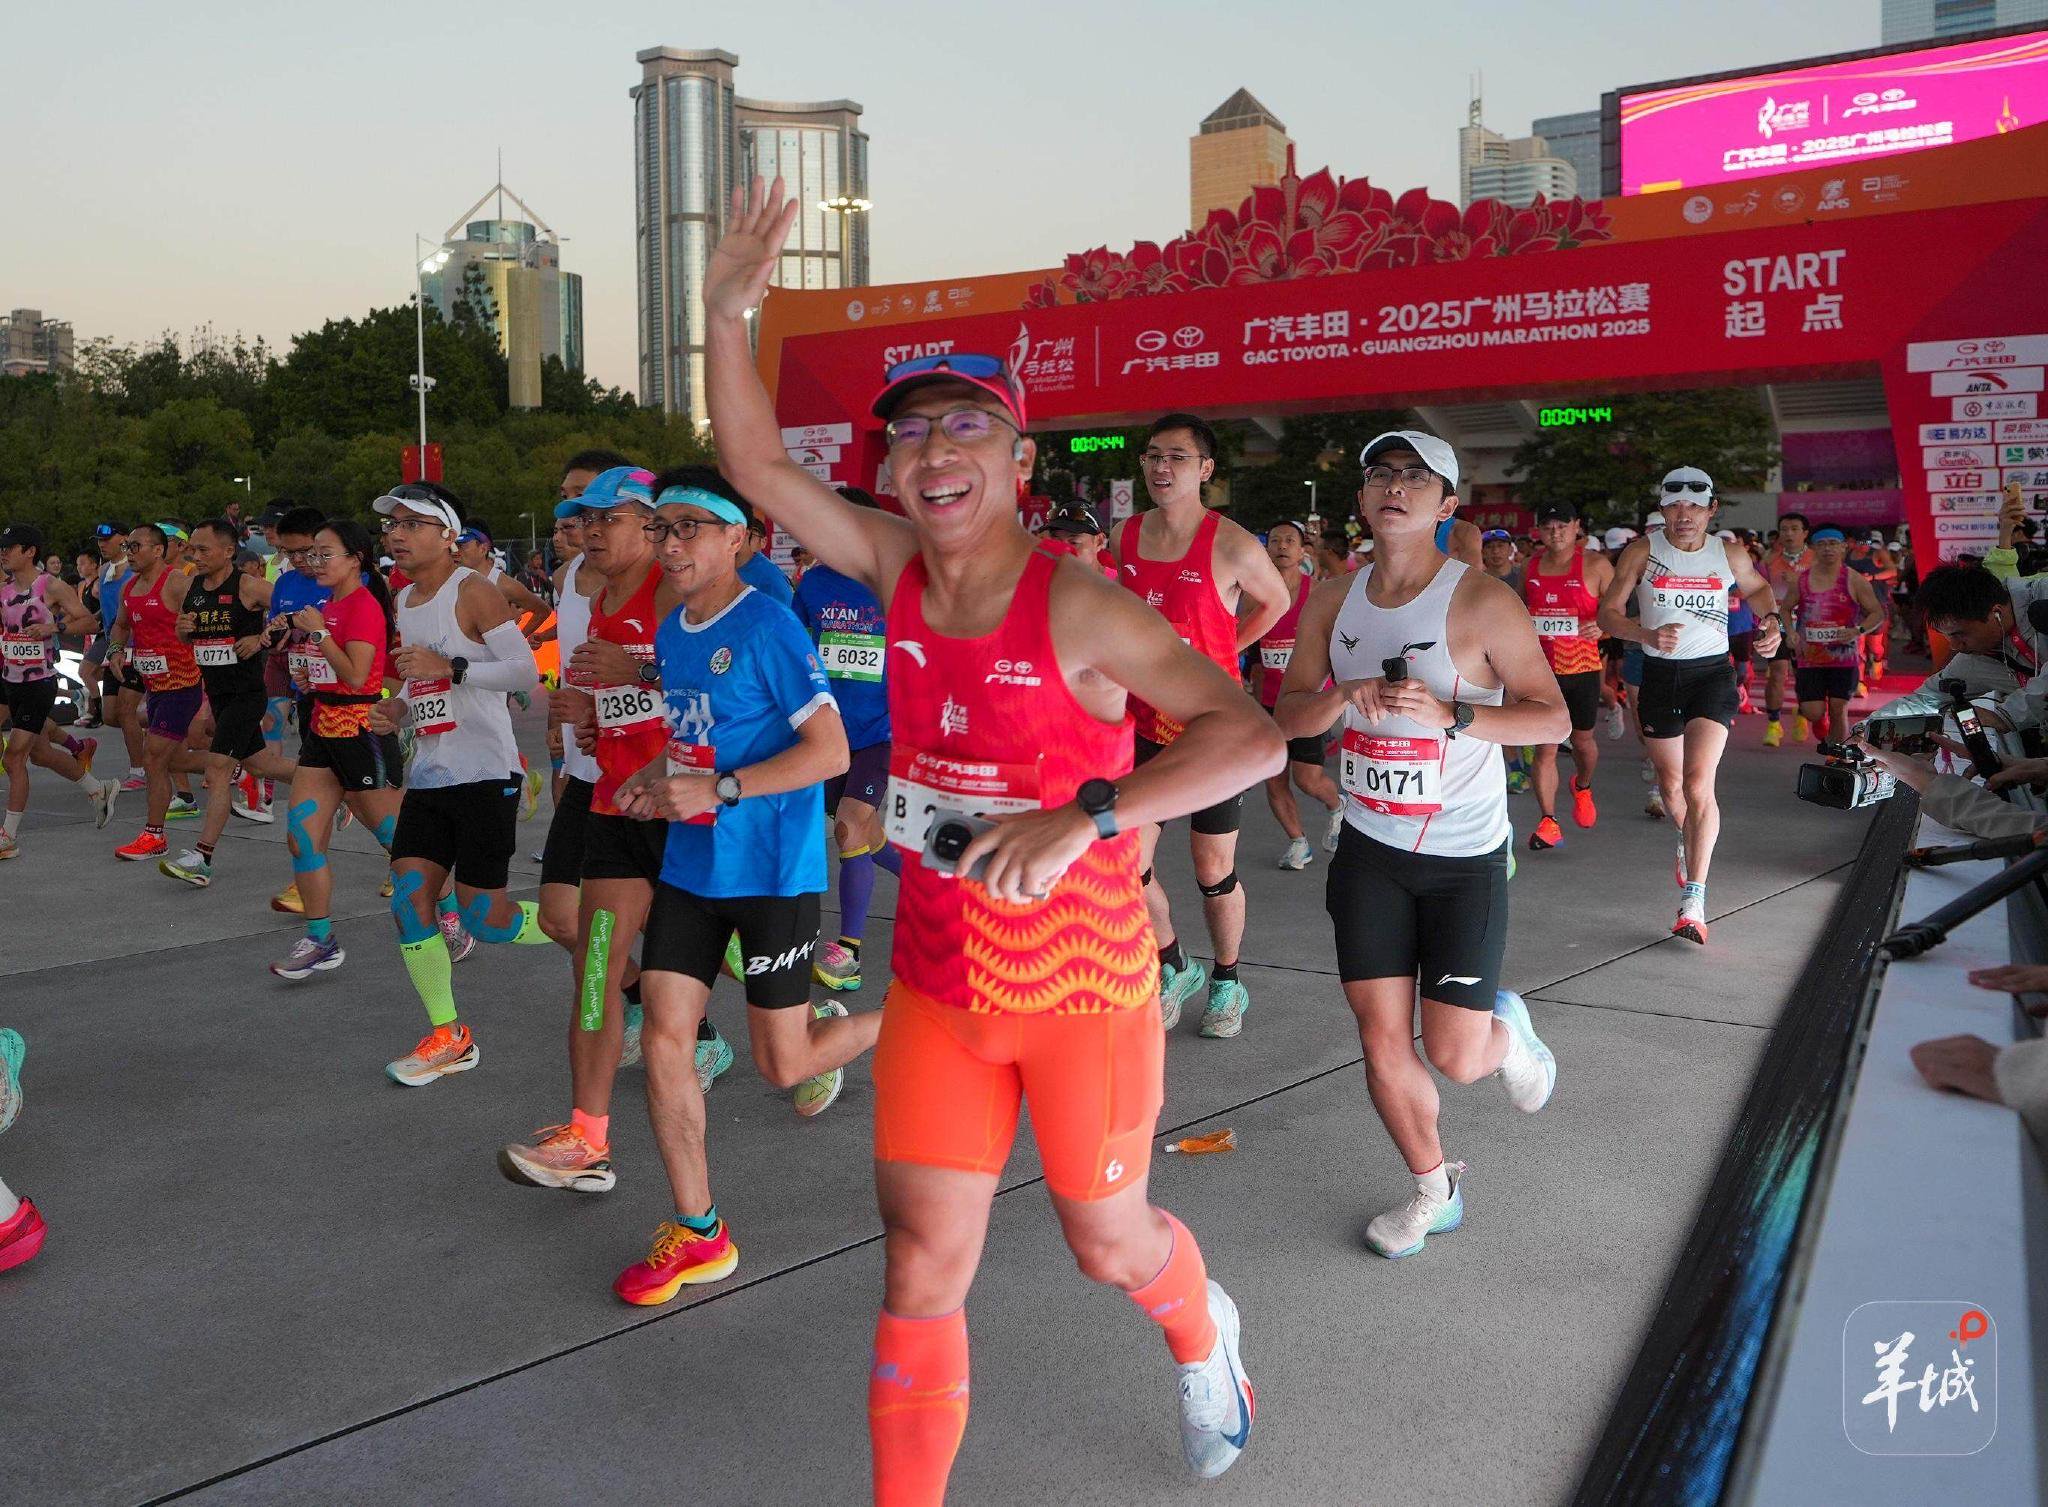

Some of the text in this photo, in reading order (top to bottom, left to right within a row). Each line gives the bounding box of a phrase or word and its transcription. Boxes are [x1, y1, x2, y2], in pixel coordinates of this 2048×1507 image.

[1723, 249, 1846, 296] START
[1242, 318, 1650, 366] GAC TOYOTA GUANGZHOU MARATHON 2025
[1121, 351, 1220, 375] 广汽丰田
[1944, 472, 1982, 488] 立白
[1674, 595, 1715, 608] 0404
[1543, 620, 1572, 632] 0173
[13, 645, 41, 656] 0055
[203, 650, 230, 661] 0771
[822, 647, 878, 667] B 6032
[602, 690, 653, 720] 2386
[1346, 760, 1424, 796] B 0171
[895, 794, 906, 819] B
